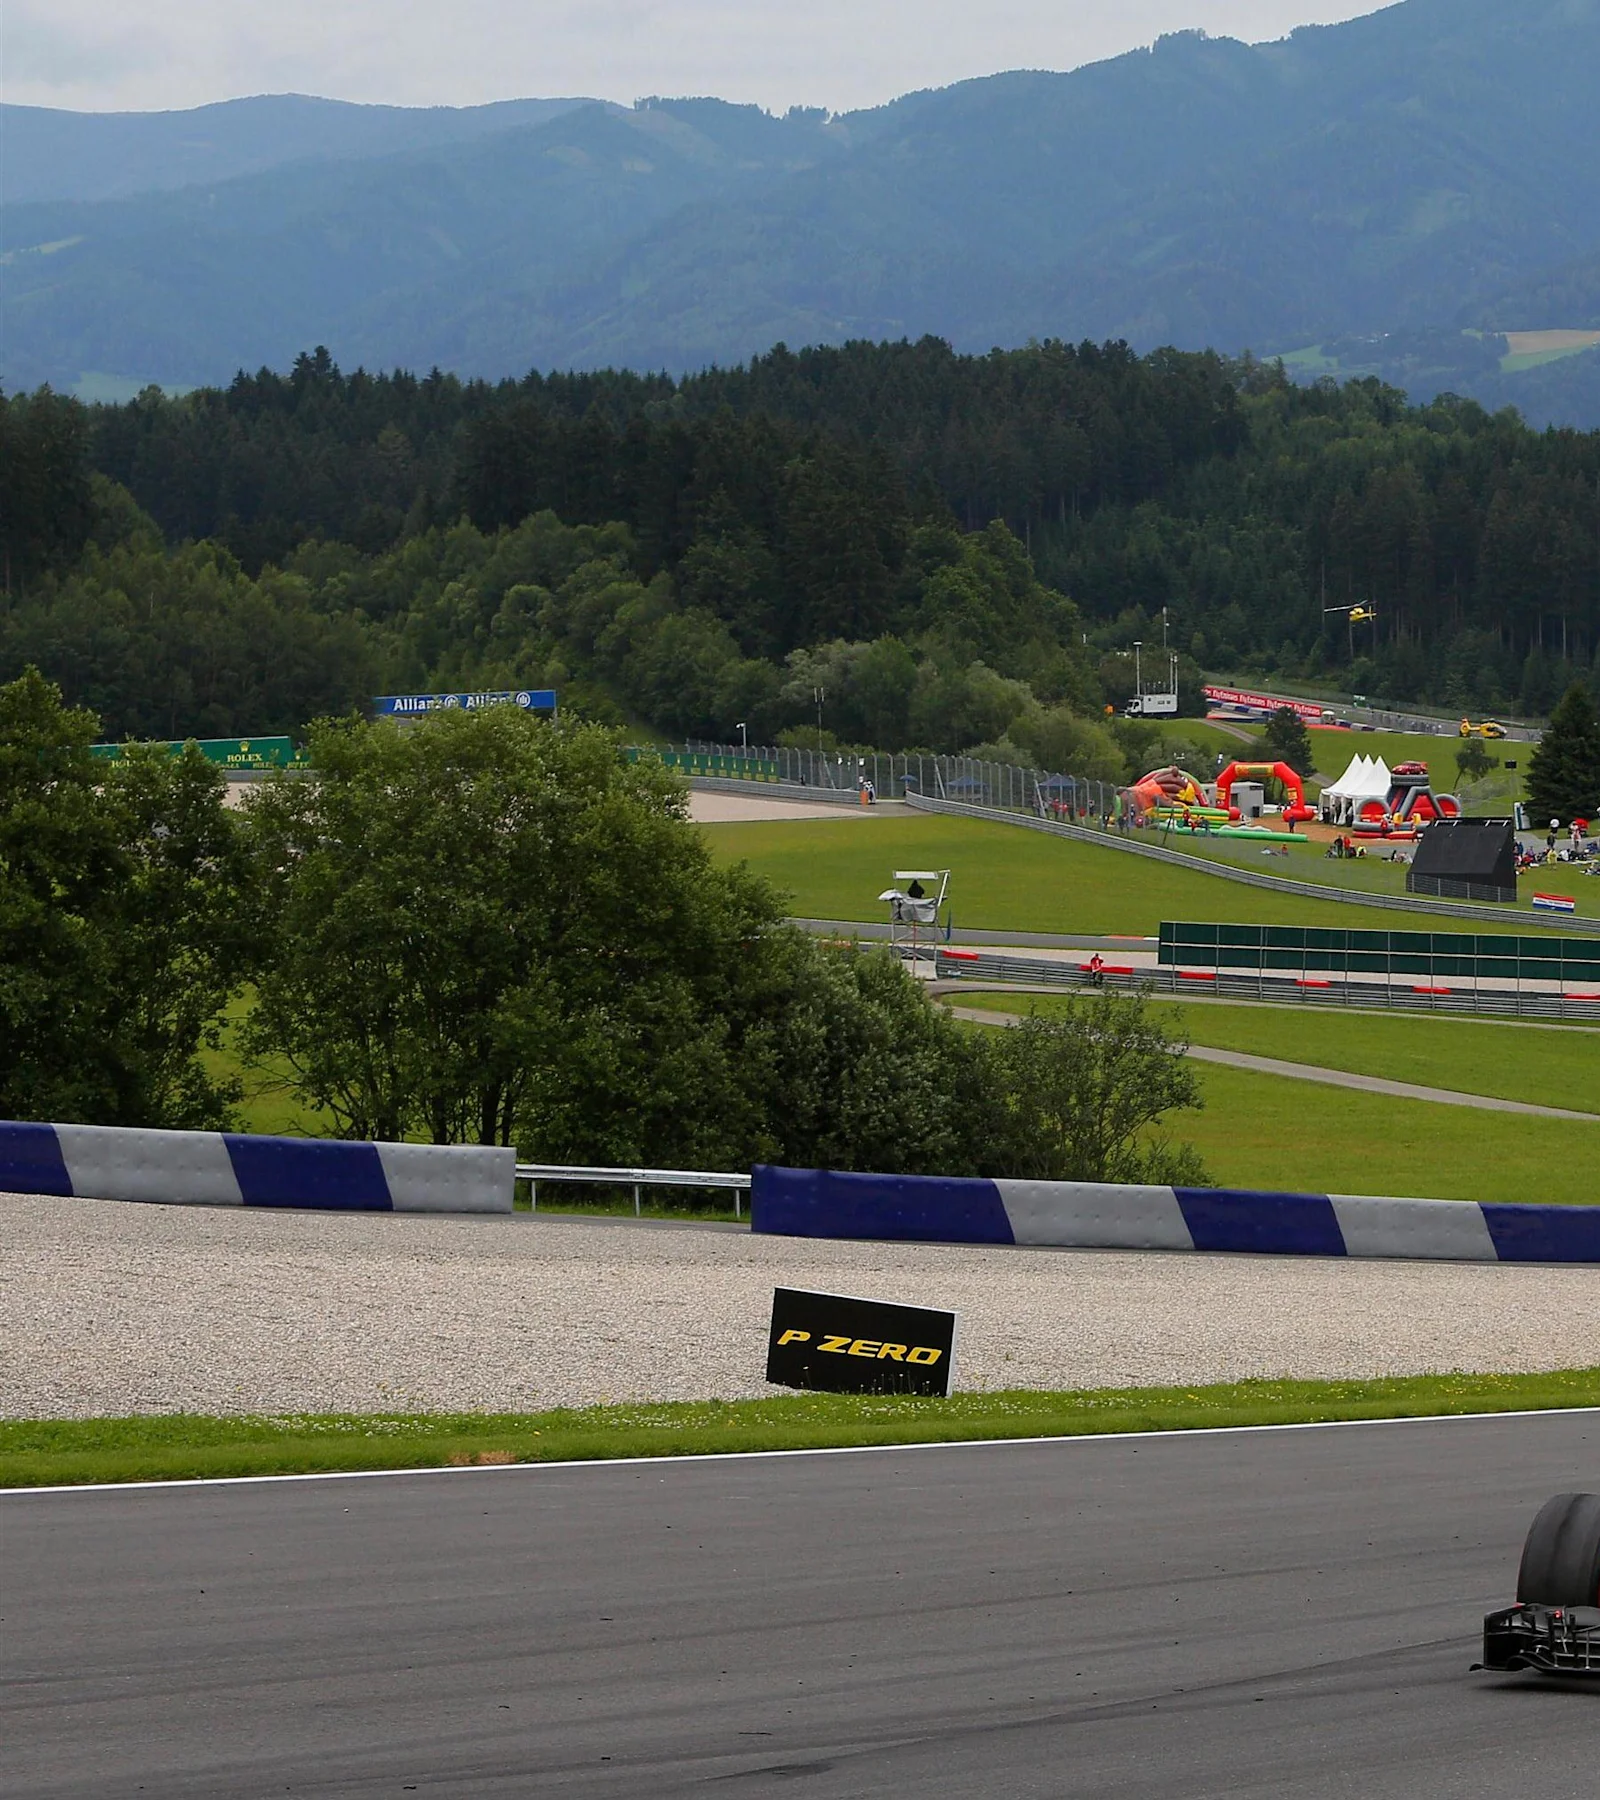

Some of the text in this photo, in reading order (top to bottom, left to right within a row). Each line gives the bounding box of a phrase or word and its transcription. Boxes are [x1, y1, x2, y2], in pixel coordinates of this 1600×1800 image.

[227, 753, 262, 762] ROLEX
[777, 1329, 943, 1365] P ZERO
